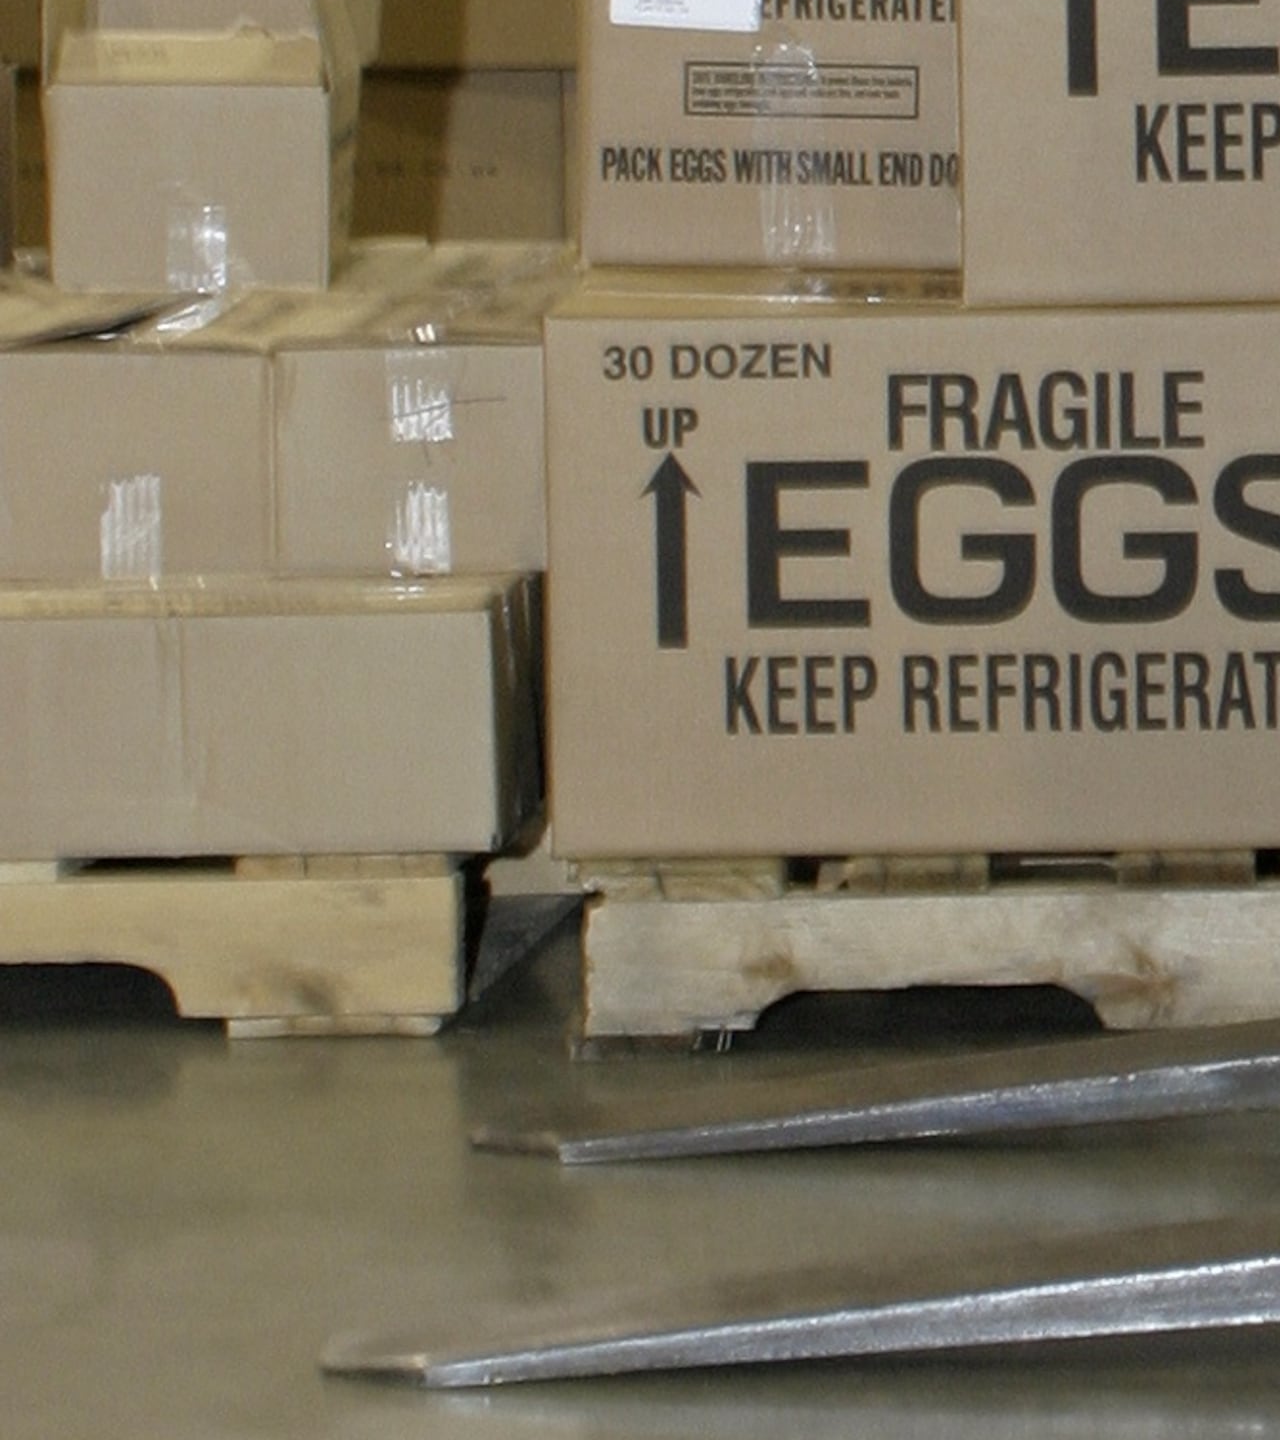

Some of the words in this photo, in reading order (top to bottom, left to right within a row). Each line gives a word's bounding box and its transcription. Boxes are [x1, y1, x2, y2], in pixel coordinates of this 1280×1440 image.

[602, 147, 663, 182] PACK
[670, 148, 727, 183] EGGS
[734, 149, 793, 185] WITH
[797, 151, 872, 186] SMALL
[878, 152, 923, 187] END
[603, 344, 653, 379] 30
[669, 342, 833, 380] DOZEN
[642, 406, 699, 448] UP
[887, 371, 1206, 451] FRAGILE
[725, 654, 879, 735] KEEP
